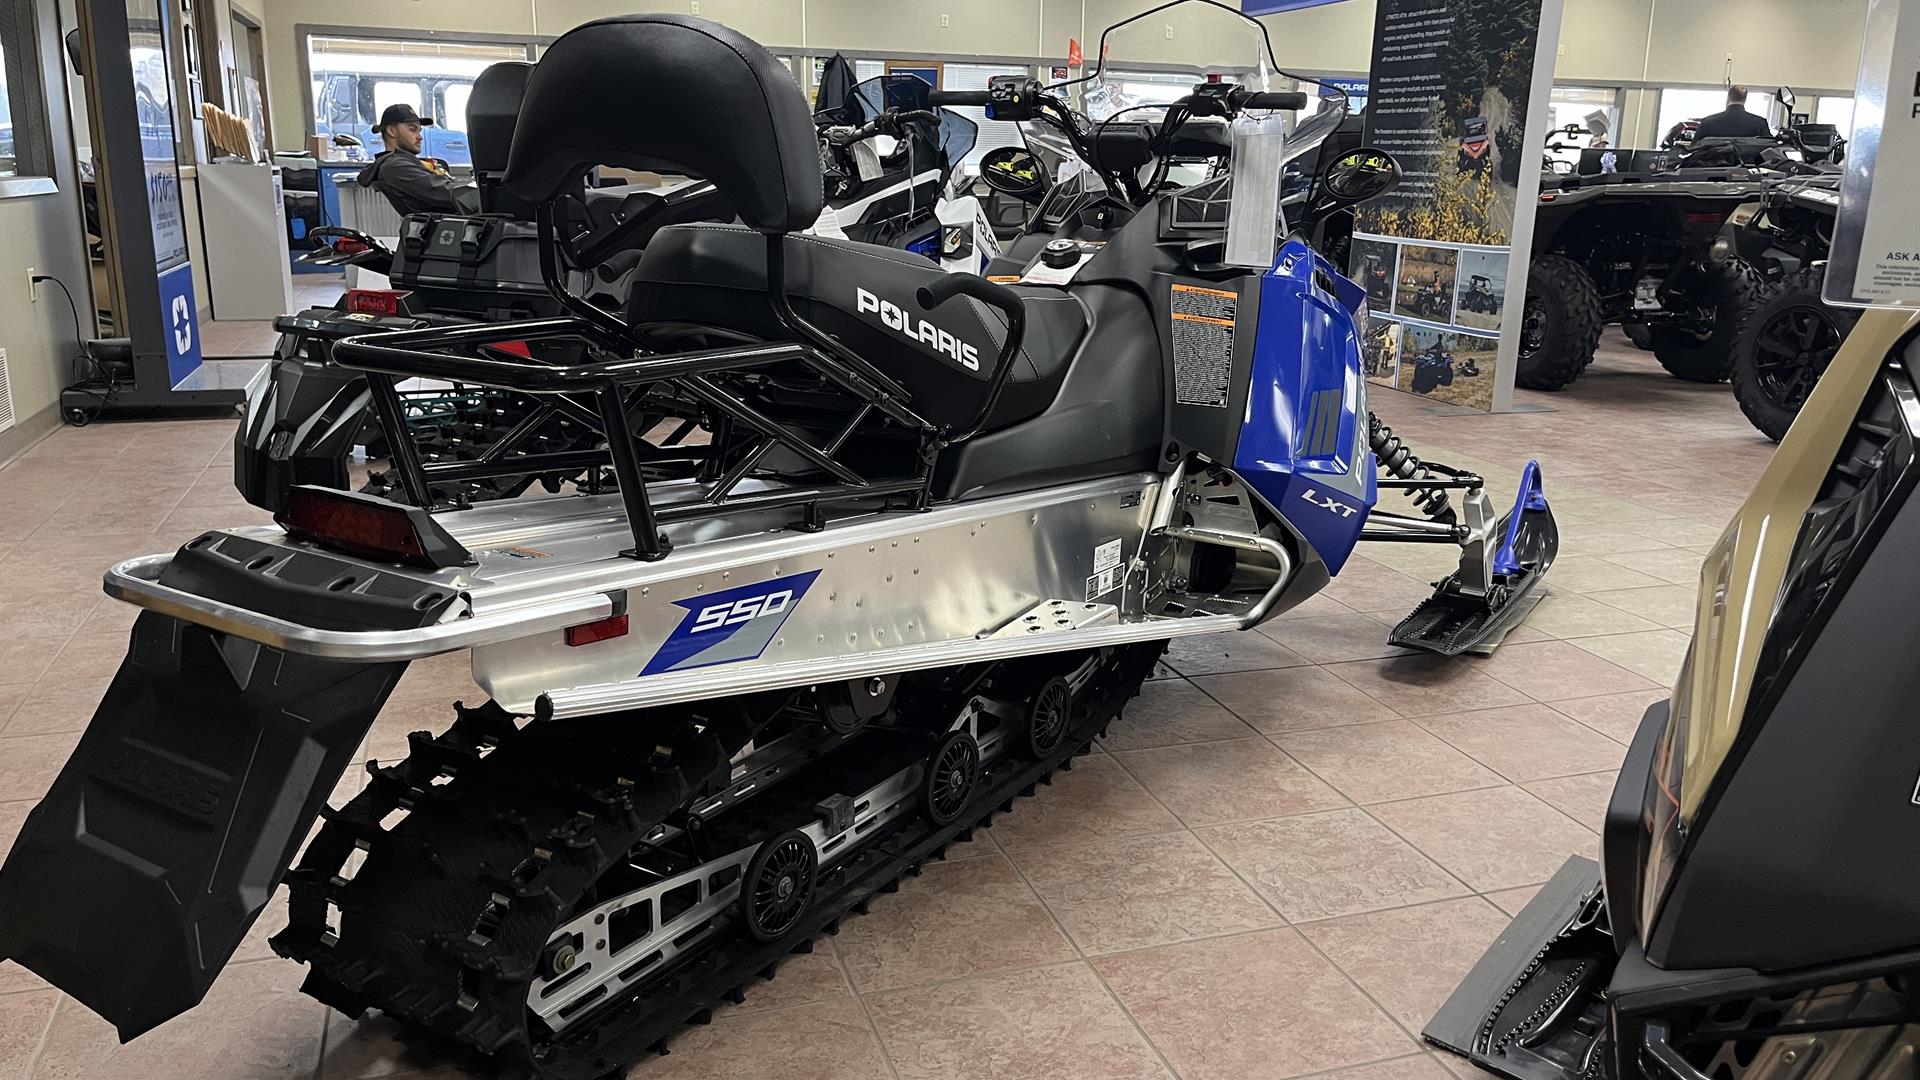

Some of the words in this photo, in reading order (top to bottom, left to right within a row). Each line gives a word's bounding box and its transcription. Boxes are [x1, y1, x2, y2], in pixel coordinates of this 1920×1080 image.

[1334, 83, 1369, 92] POLARI
[1887, 252, 1910, 261] ASK
[857, 287, 979, 372] POLARIS
[1302, 489, 1357, 518] LXT
[690, 590, 793, 634] 550
